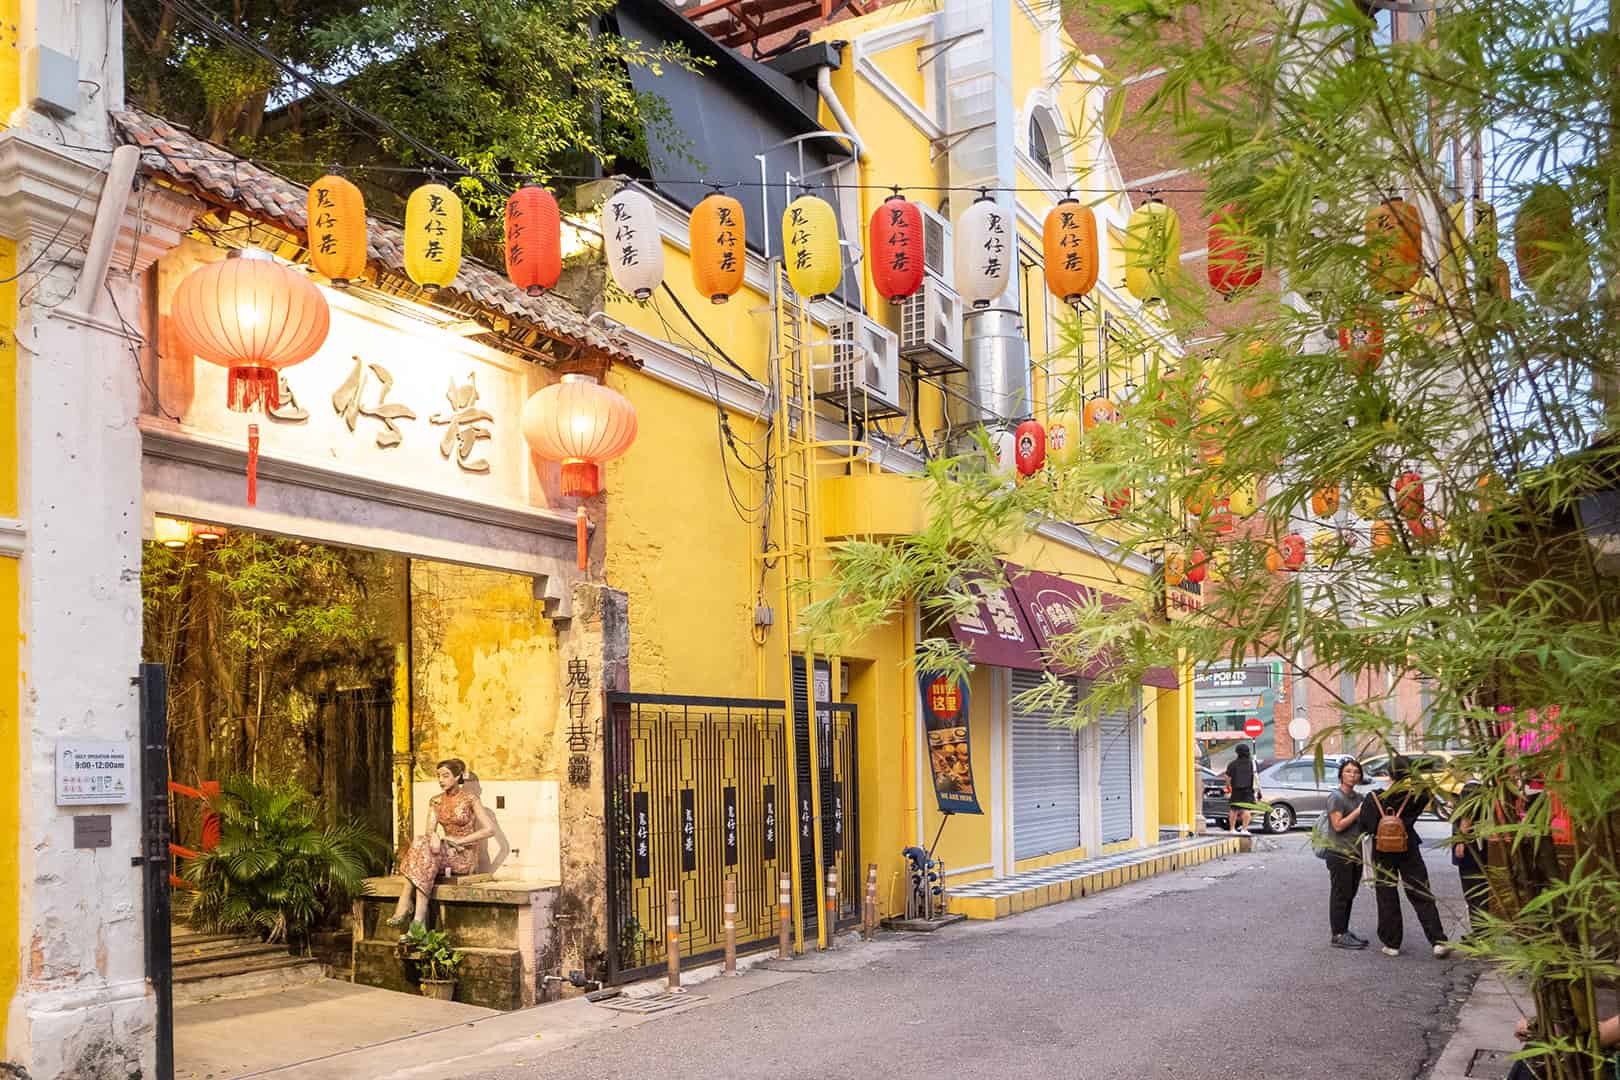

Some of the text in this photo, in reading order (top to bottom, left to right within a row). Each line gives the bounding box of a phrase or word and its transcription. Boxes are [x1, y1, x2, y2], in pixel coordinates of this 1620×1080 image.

[266, 355, 494, 475] 仔巷
[565, 656, 592, 752] 鬼仔巷
[932, 697, 957, 711] 这里
